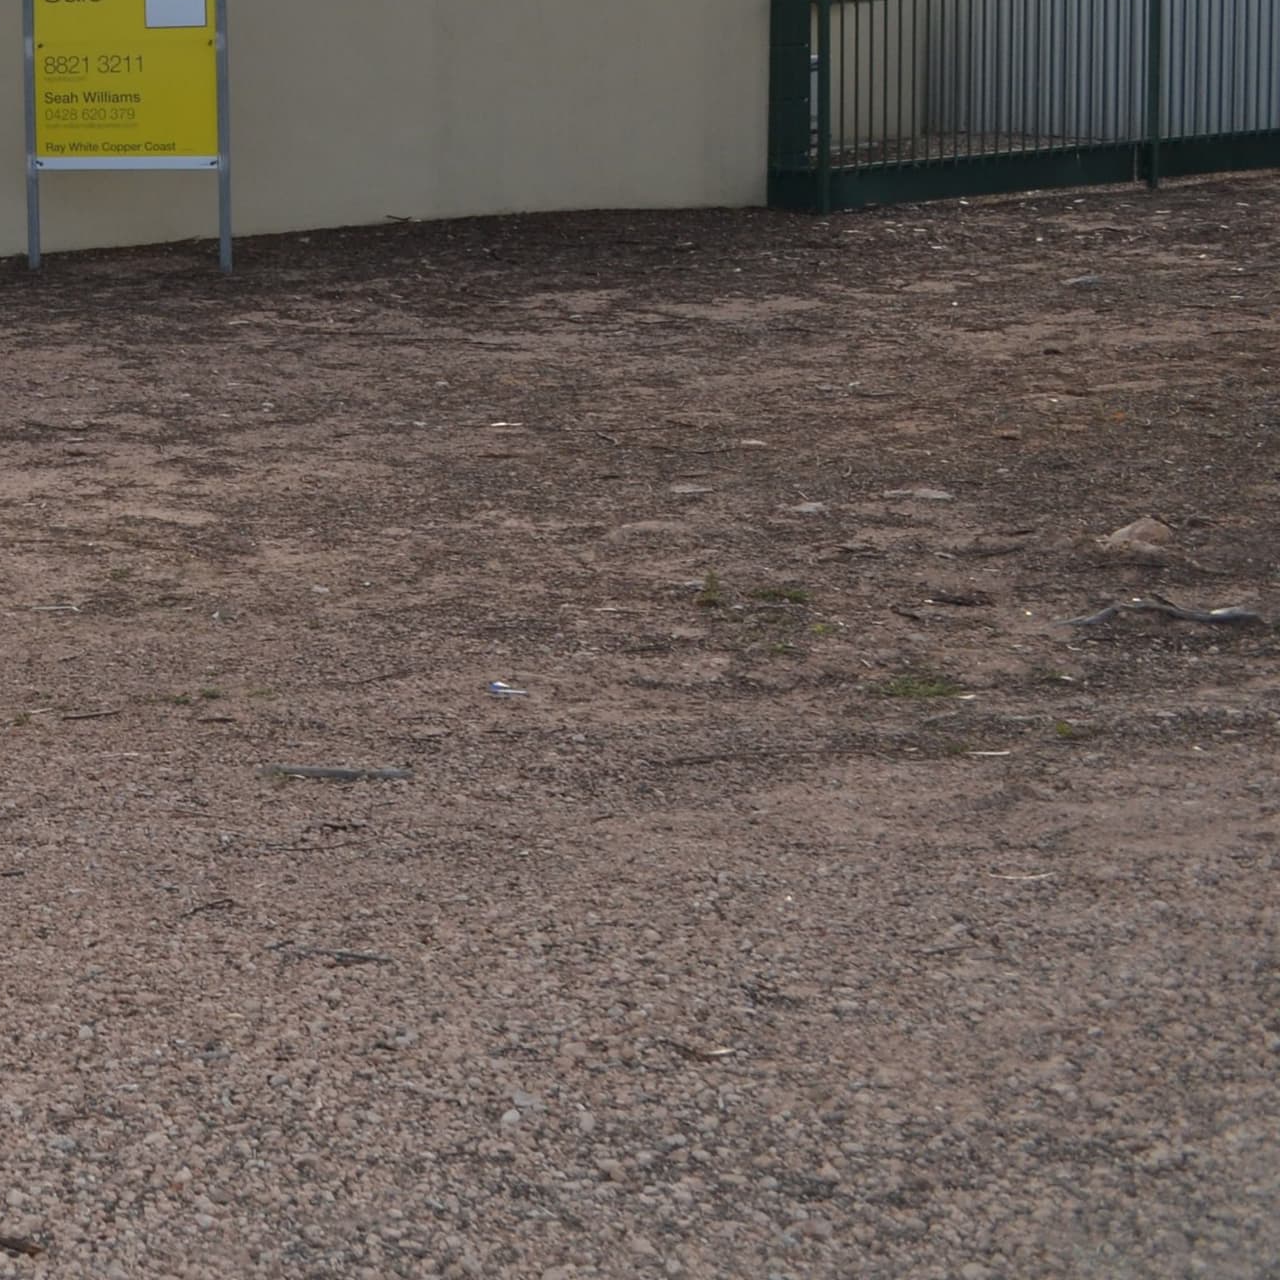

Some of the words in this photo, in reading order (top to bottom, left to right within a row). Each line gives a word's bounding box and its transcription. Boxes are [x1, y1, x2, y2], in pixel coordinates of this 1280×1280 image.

[44, 55, 90, 74] 8821
[97, 55, 143, 73] 3211
[83, 91, 141, 104] Williams
[45, 108, 78, 120] 0428
[82, 108, 107, 120] 620
[110, 107, 135, 120] 379
[46, 142, 65, 153] Ray
[69, 141, 99, 152] White
[101, 141, 141, 153] Copper
[144, 141, 176, 152] Coast
